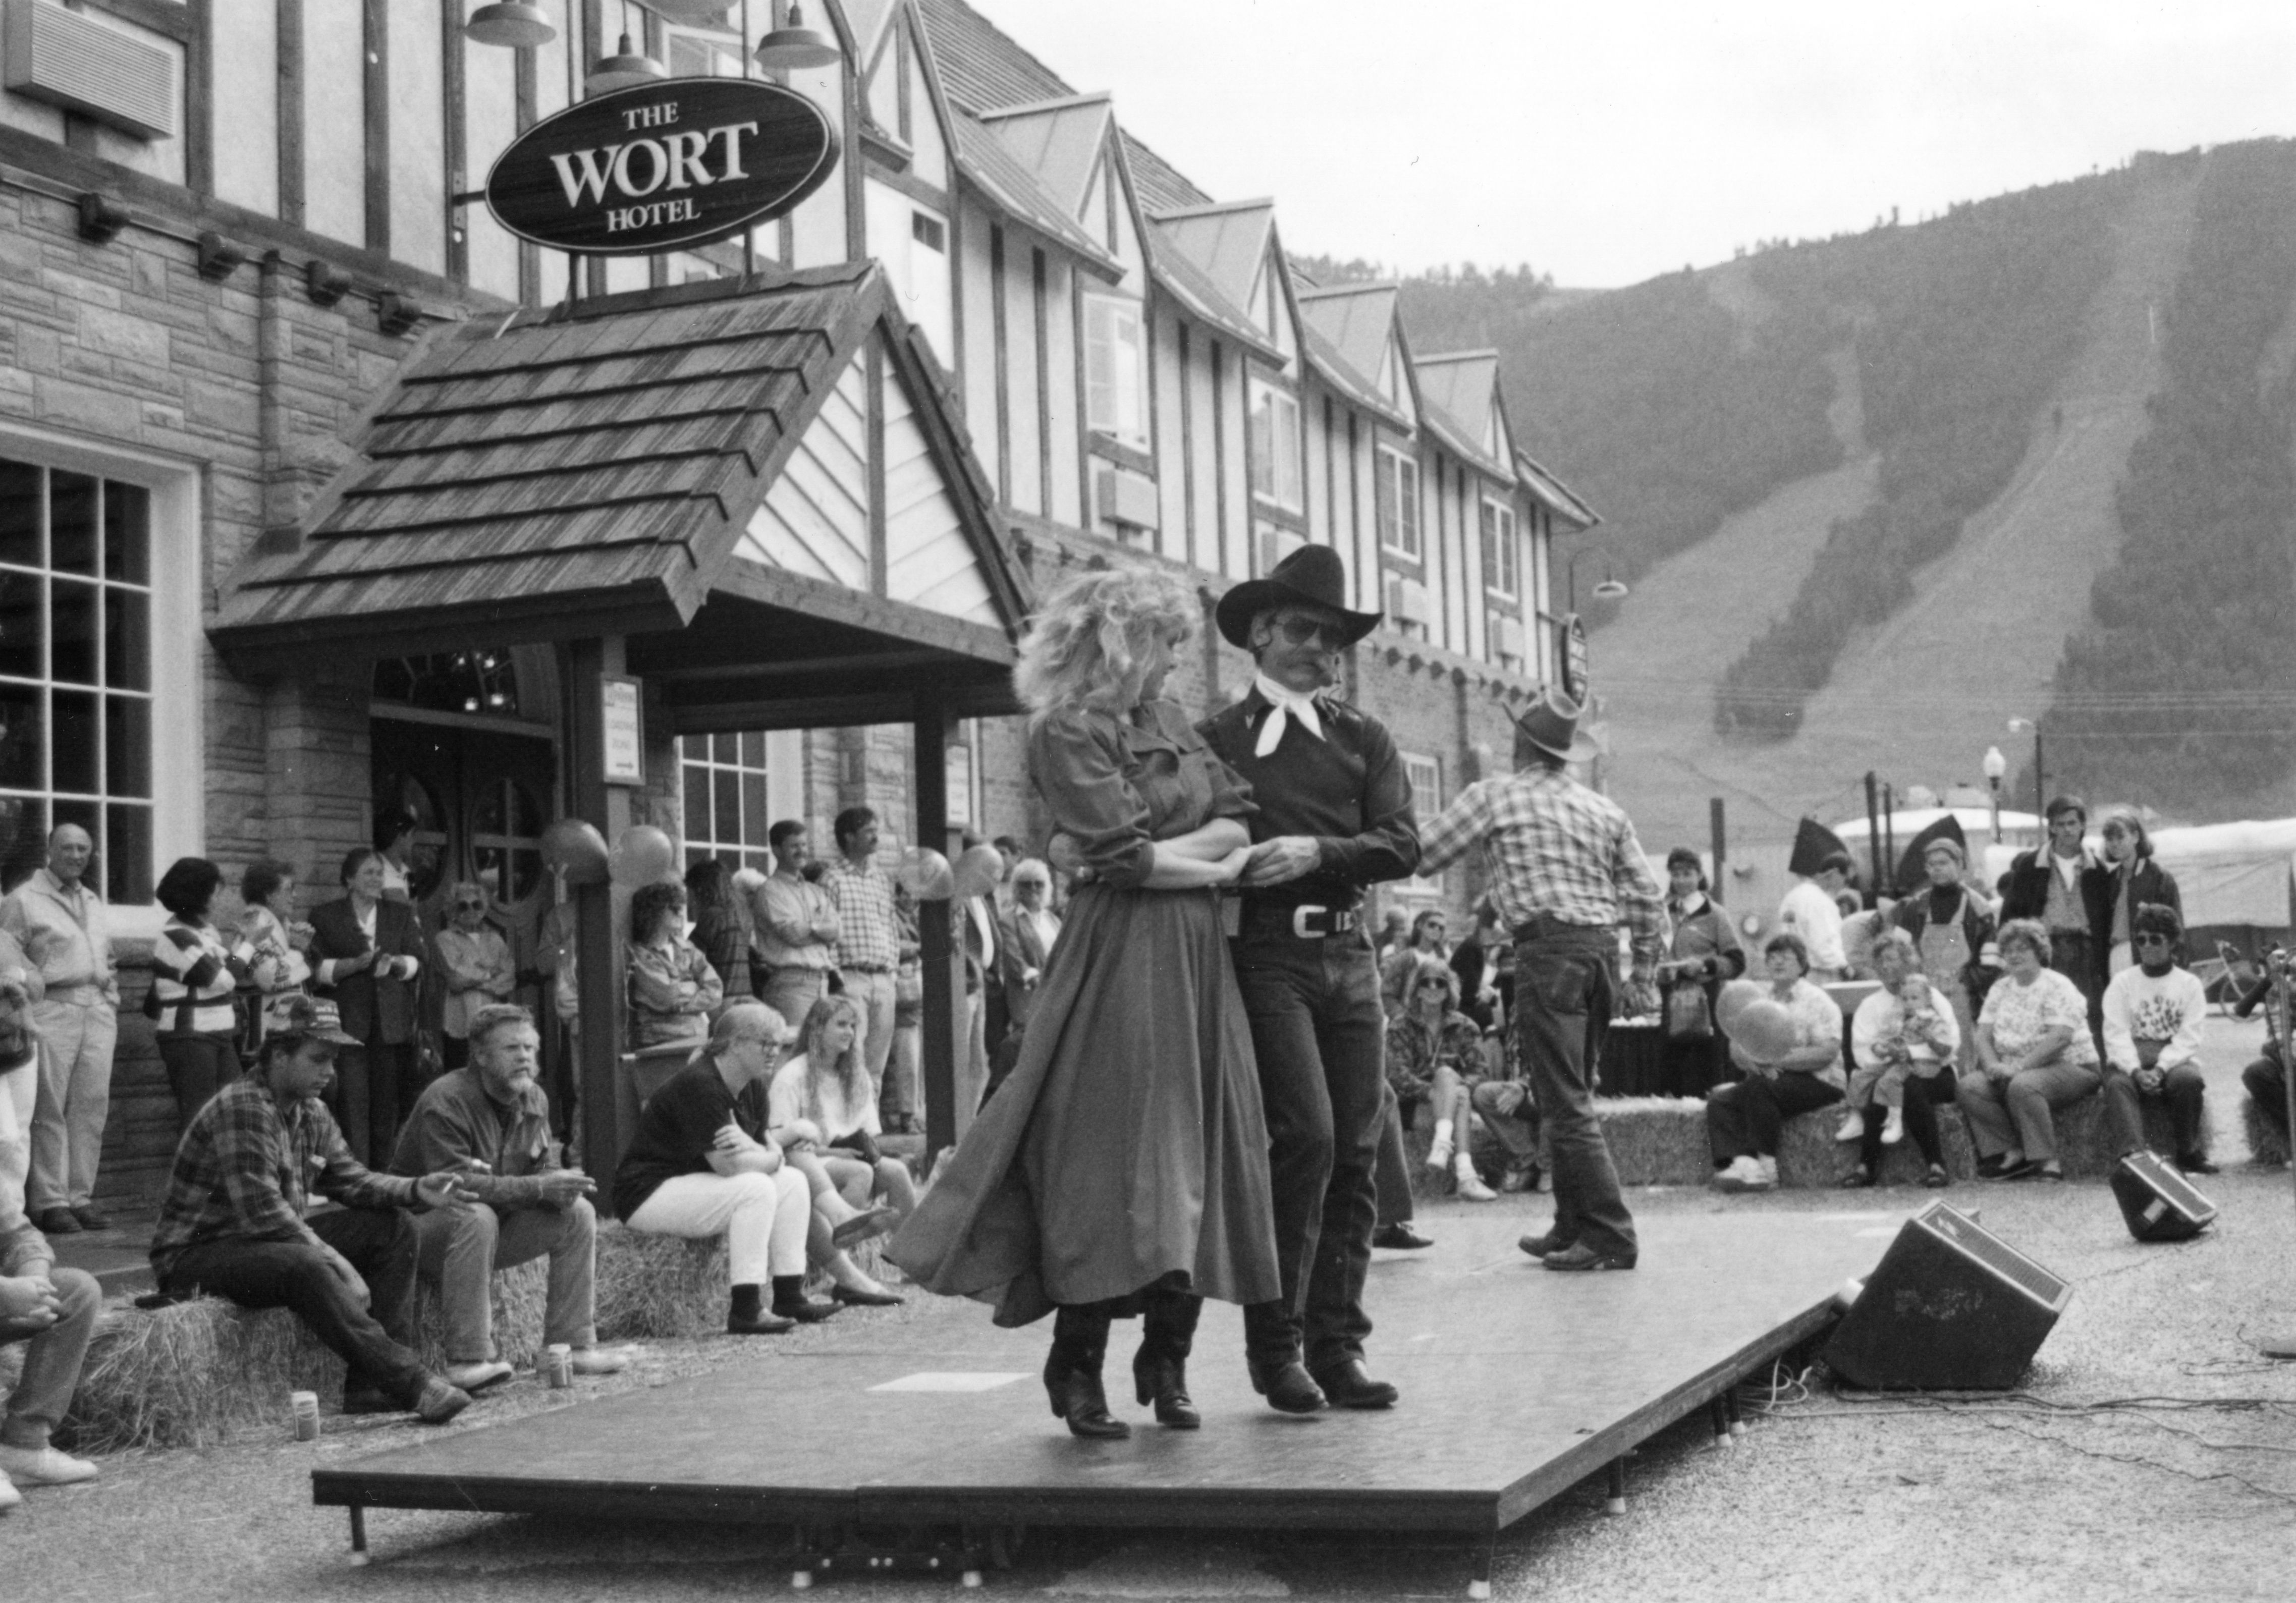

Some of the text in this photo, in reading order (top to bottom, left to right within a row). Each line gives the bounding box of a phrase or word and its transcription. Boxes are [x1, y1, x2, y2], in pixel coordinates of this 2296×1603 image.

[623, 102, 679, 130] THE
[550, 121, 758, 208] WORT
[606, 198, 701, 232] HOTEL
